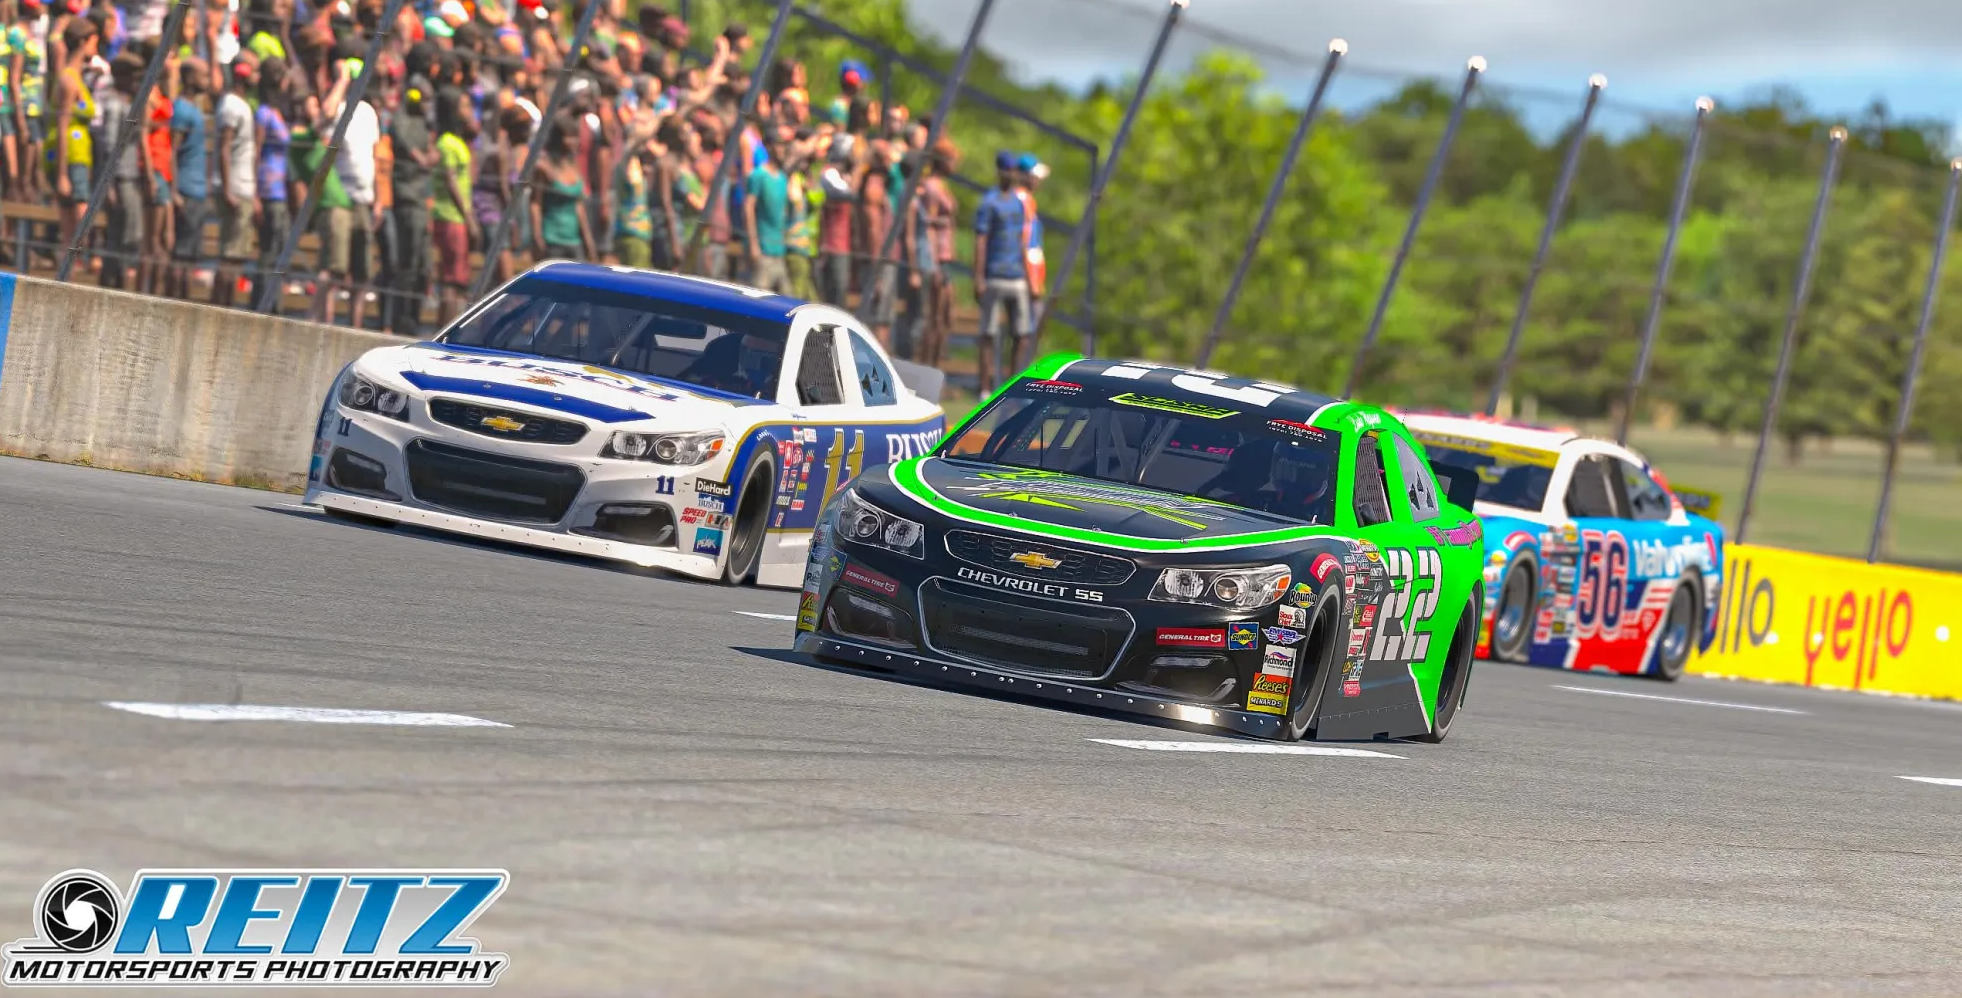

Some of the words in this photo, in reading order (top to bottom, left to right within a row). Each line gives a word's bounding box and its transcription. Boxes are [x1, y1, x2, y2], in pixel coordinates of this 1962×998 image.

[337, 416, 352, 437] 11
[816, 428, 865, 522] 11
[655, 475, 675, 495] 11
[697, 480, 731, 496] DieHard
[680, 515, 697, 525] PRO
[682, 507, 708, 518] SPEED
[845, 570, 871, 583] GENERAL
[957, 567, 1070, 597] CHEVROLET
[1075, 588, 1104, 602] SS
[1576, 529, 1630, 641] 56
[1288, 589, 1318, 607] Bounty
[1369, 547, 1443, 662] 22
[1278, 618, 1292, 626] Chief
[1279, 611, 1293, 619] Sioux
[1159, 633, 1193, 641] GENERAL
[1230, 632, 1257, 642] SUNOCO
[1803, 587, 1914, 690] yello
[1264, 654, 1294, 667] Richmond
[1253, 674, 1289, 694] Reese's
[1250, 696, 1283, 708] MENARDS
